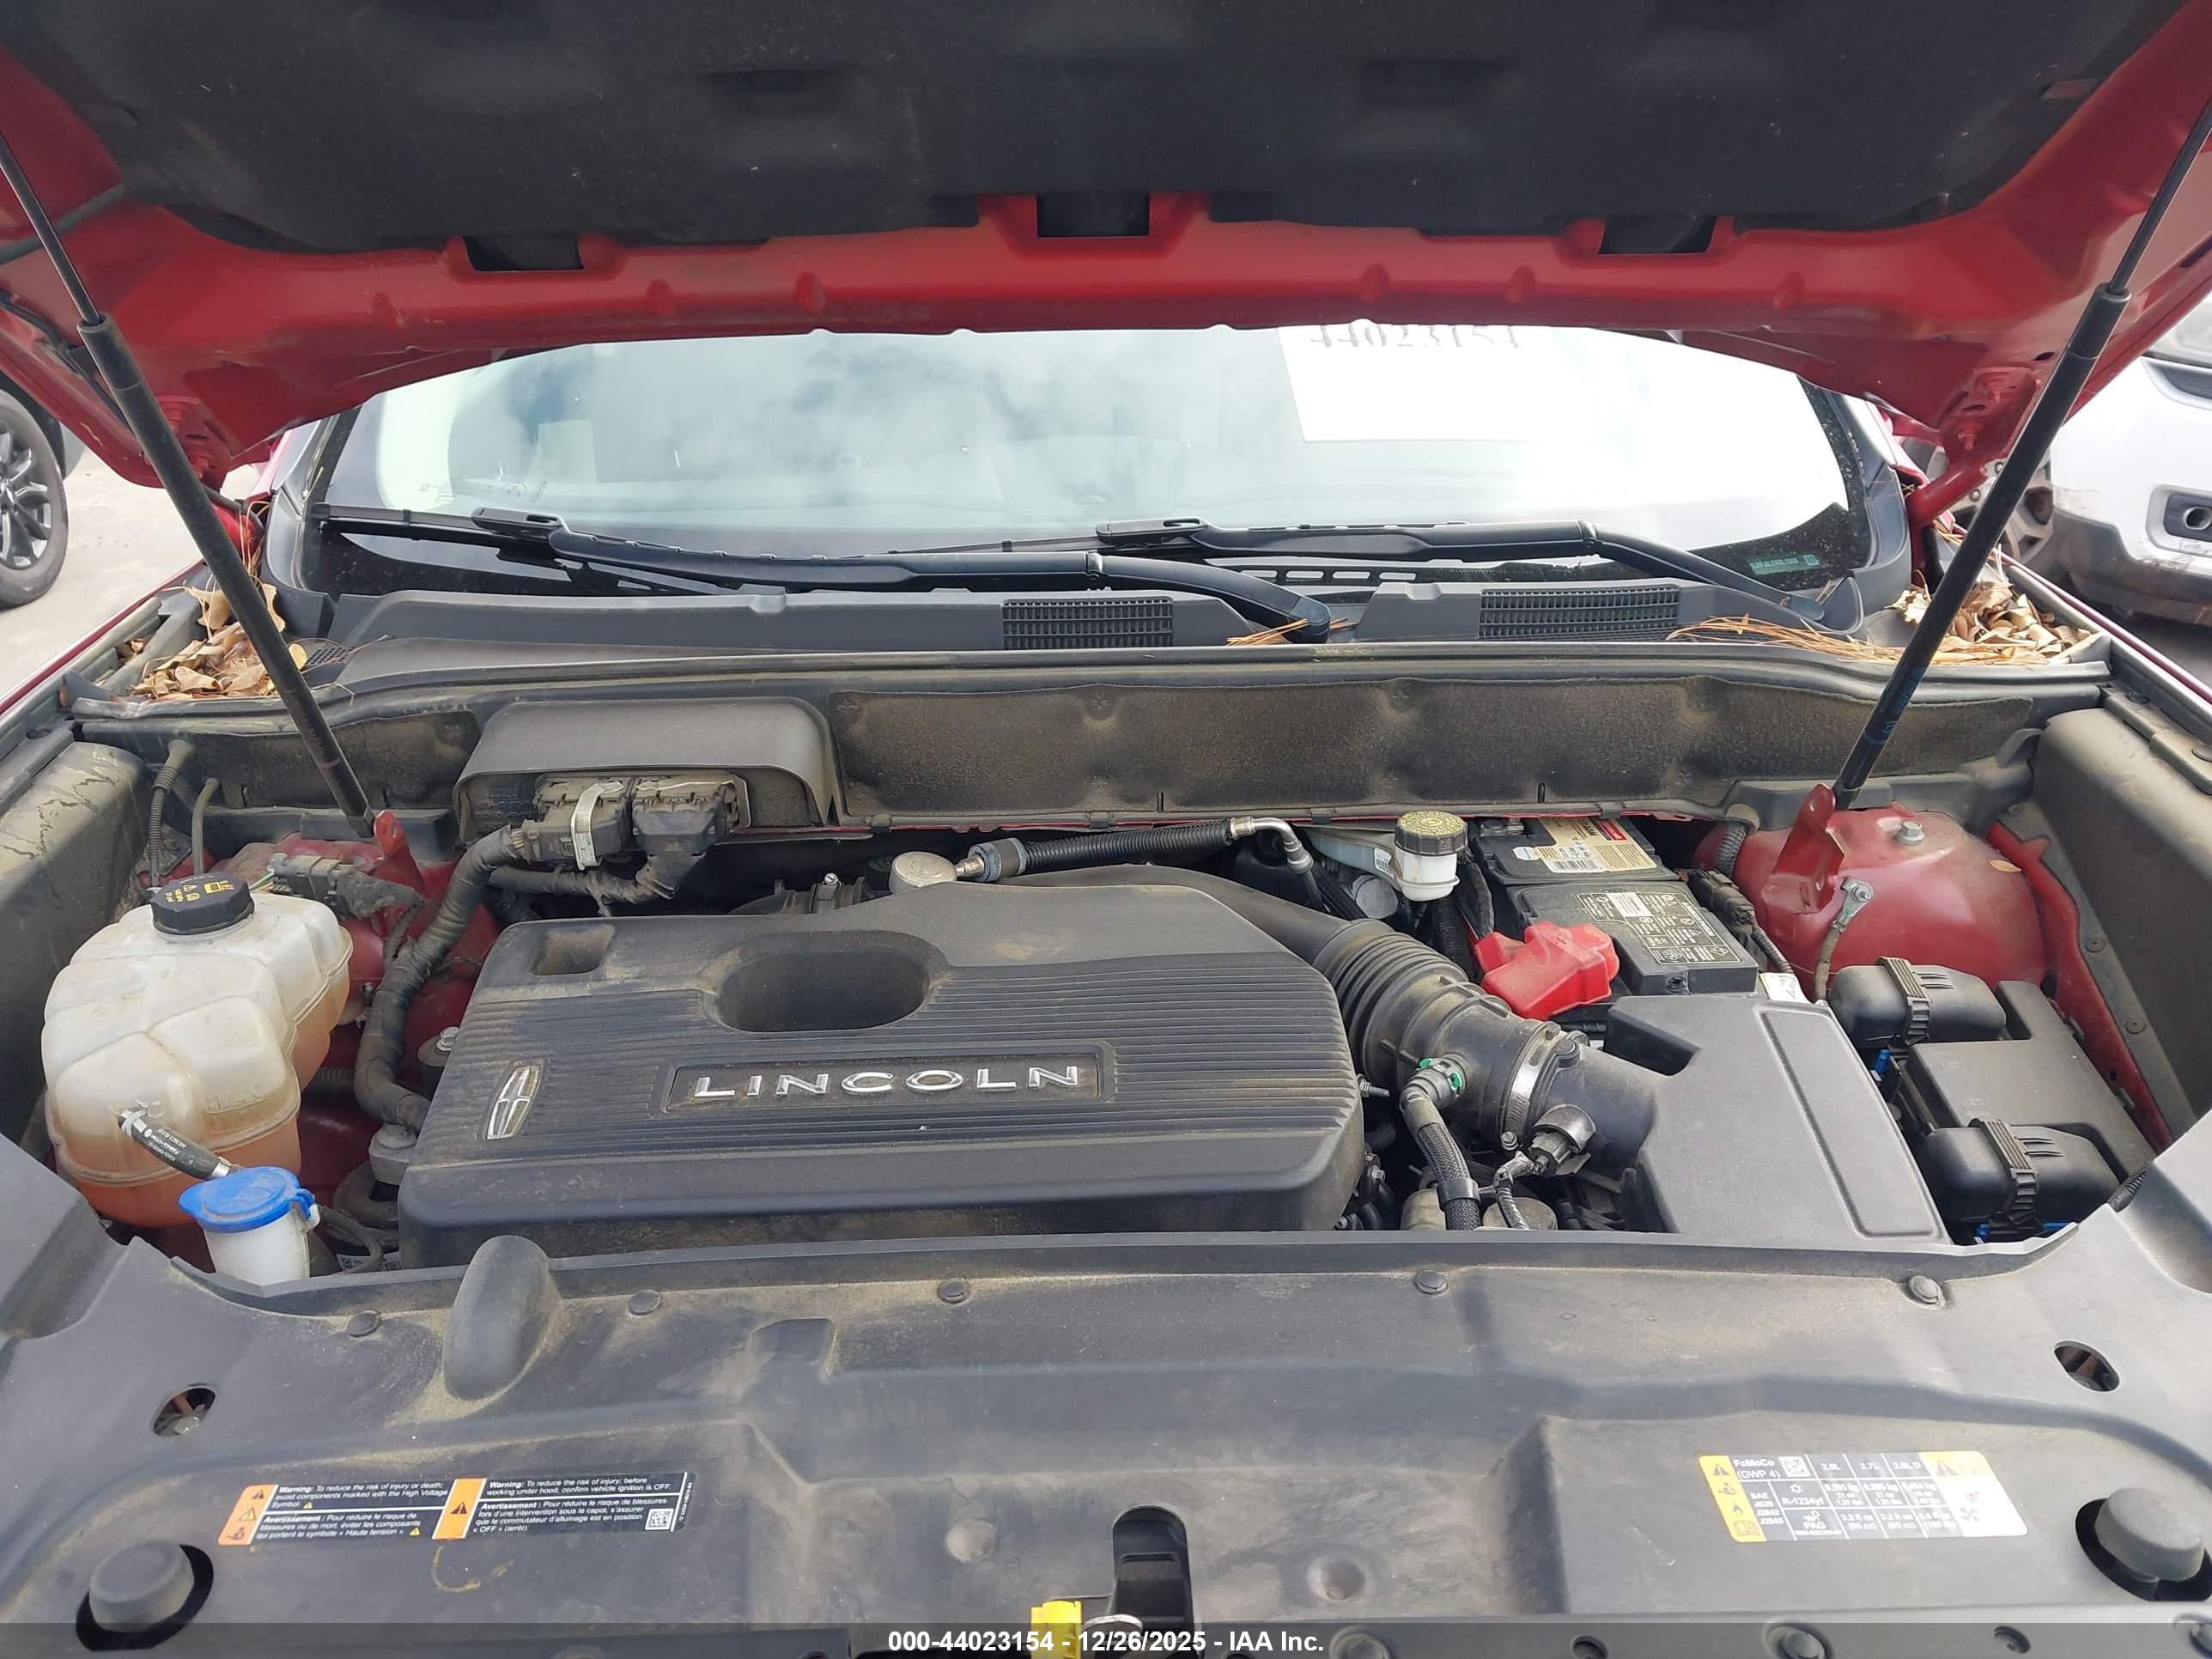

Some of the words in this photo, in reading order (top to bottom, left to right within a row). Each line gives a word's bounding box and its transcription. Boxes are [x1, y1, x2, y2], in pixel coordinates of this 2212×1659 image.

[694, 1065, 1079, 1098] LINCOLN
[1737, 1470, 1766, 1479] (GWP
[306, 1530, 337, 1539] symbole
